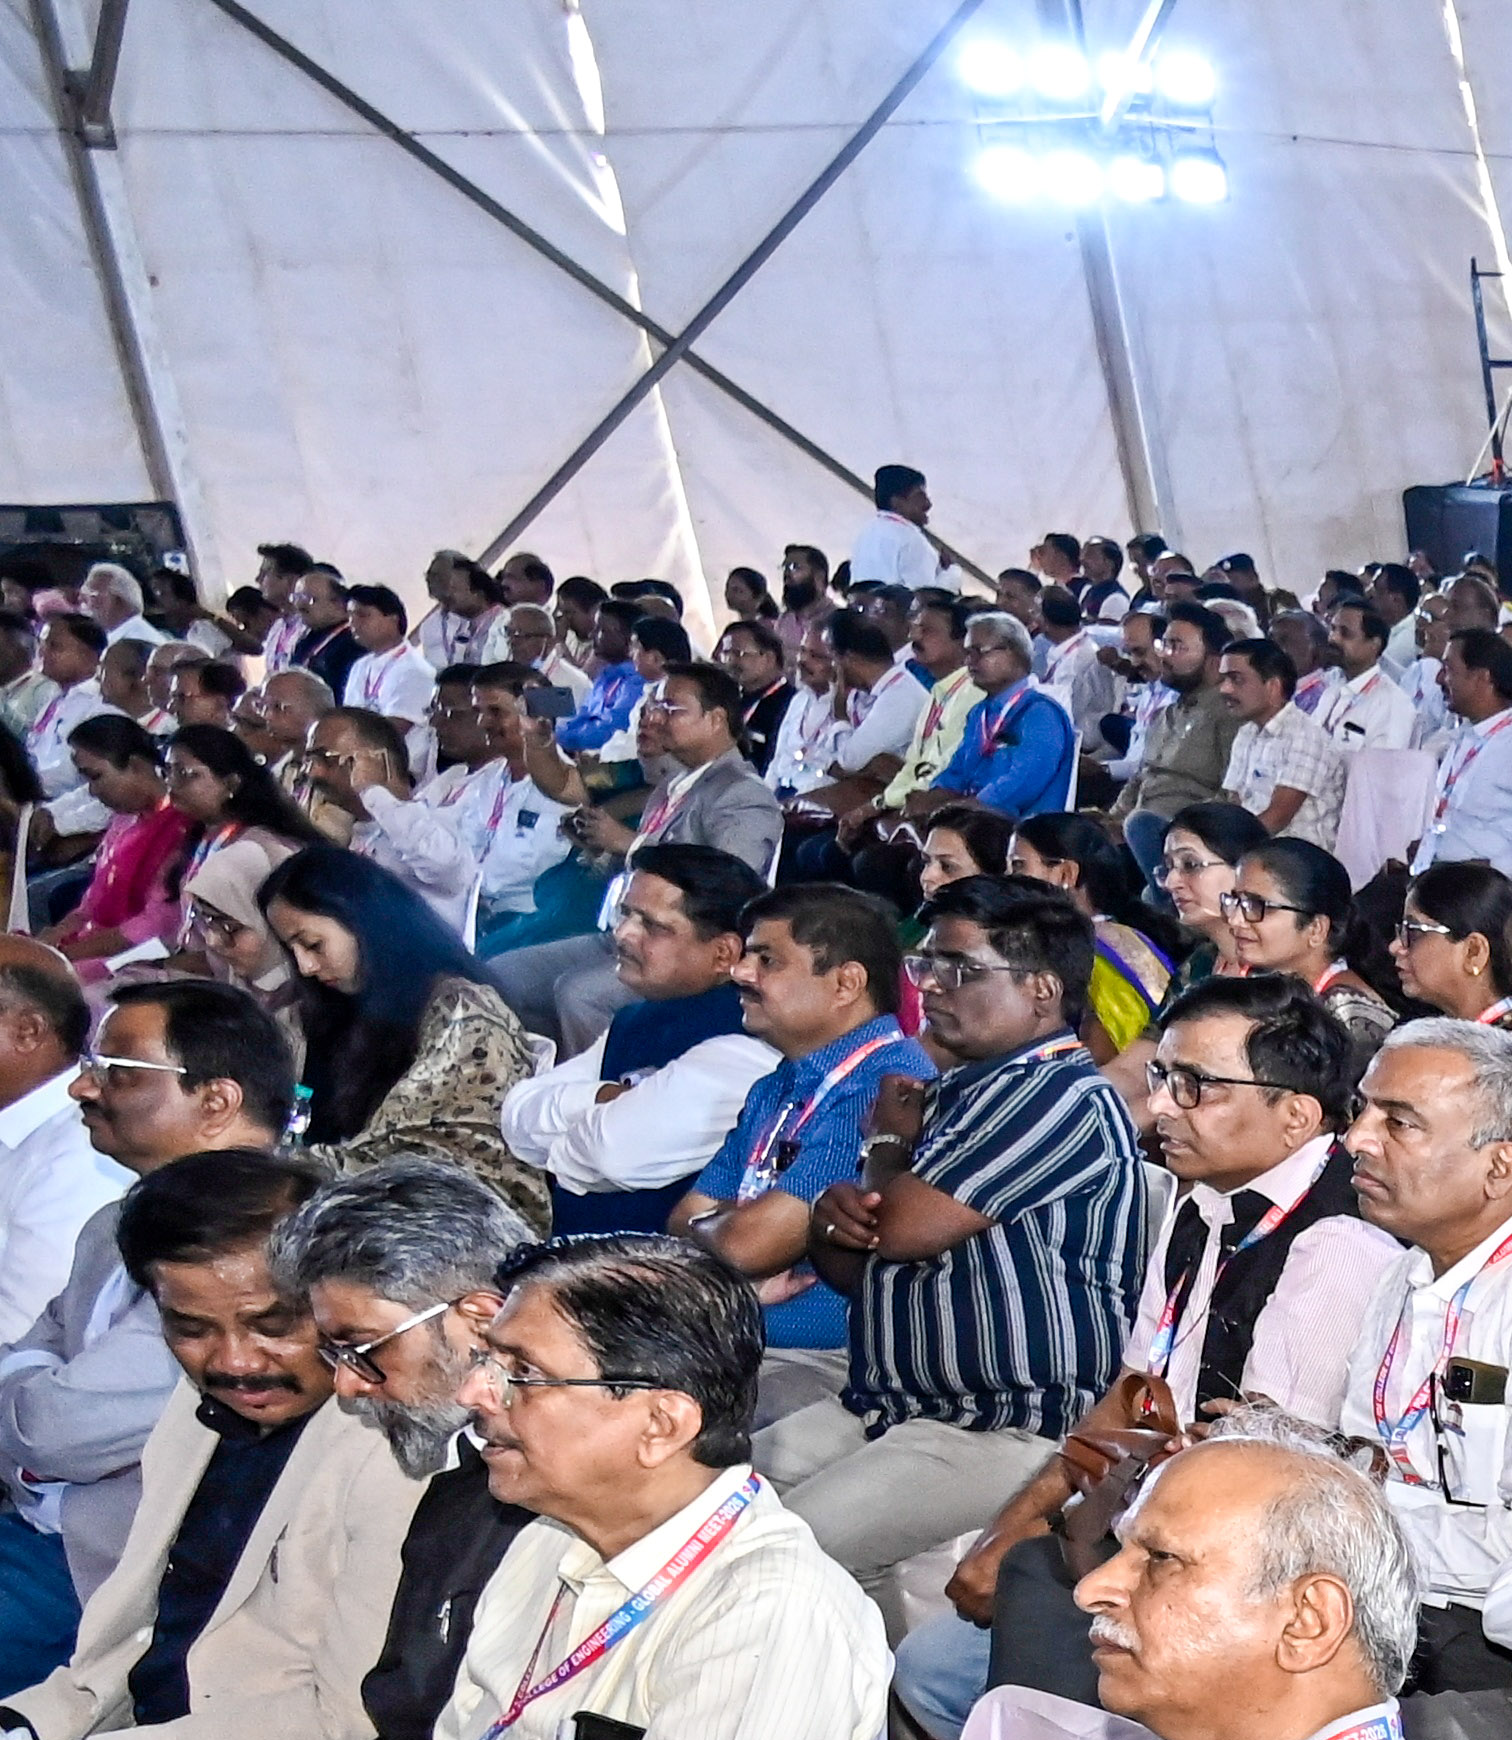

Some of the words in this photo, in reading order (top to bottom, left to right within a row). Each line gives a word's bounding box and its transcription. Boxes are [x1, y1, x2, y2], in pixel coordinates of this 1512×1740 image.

[558, 1663, 573, 1678] OF
[570, 1611, 632, 1667] ENGINEERING
[631, 1573, 672, 1612] GLOBAL
[667, 1539, 705, 1579] ALUMNI
